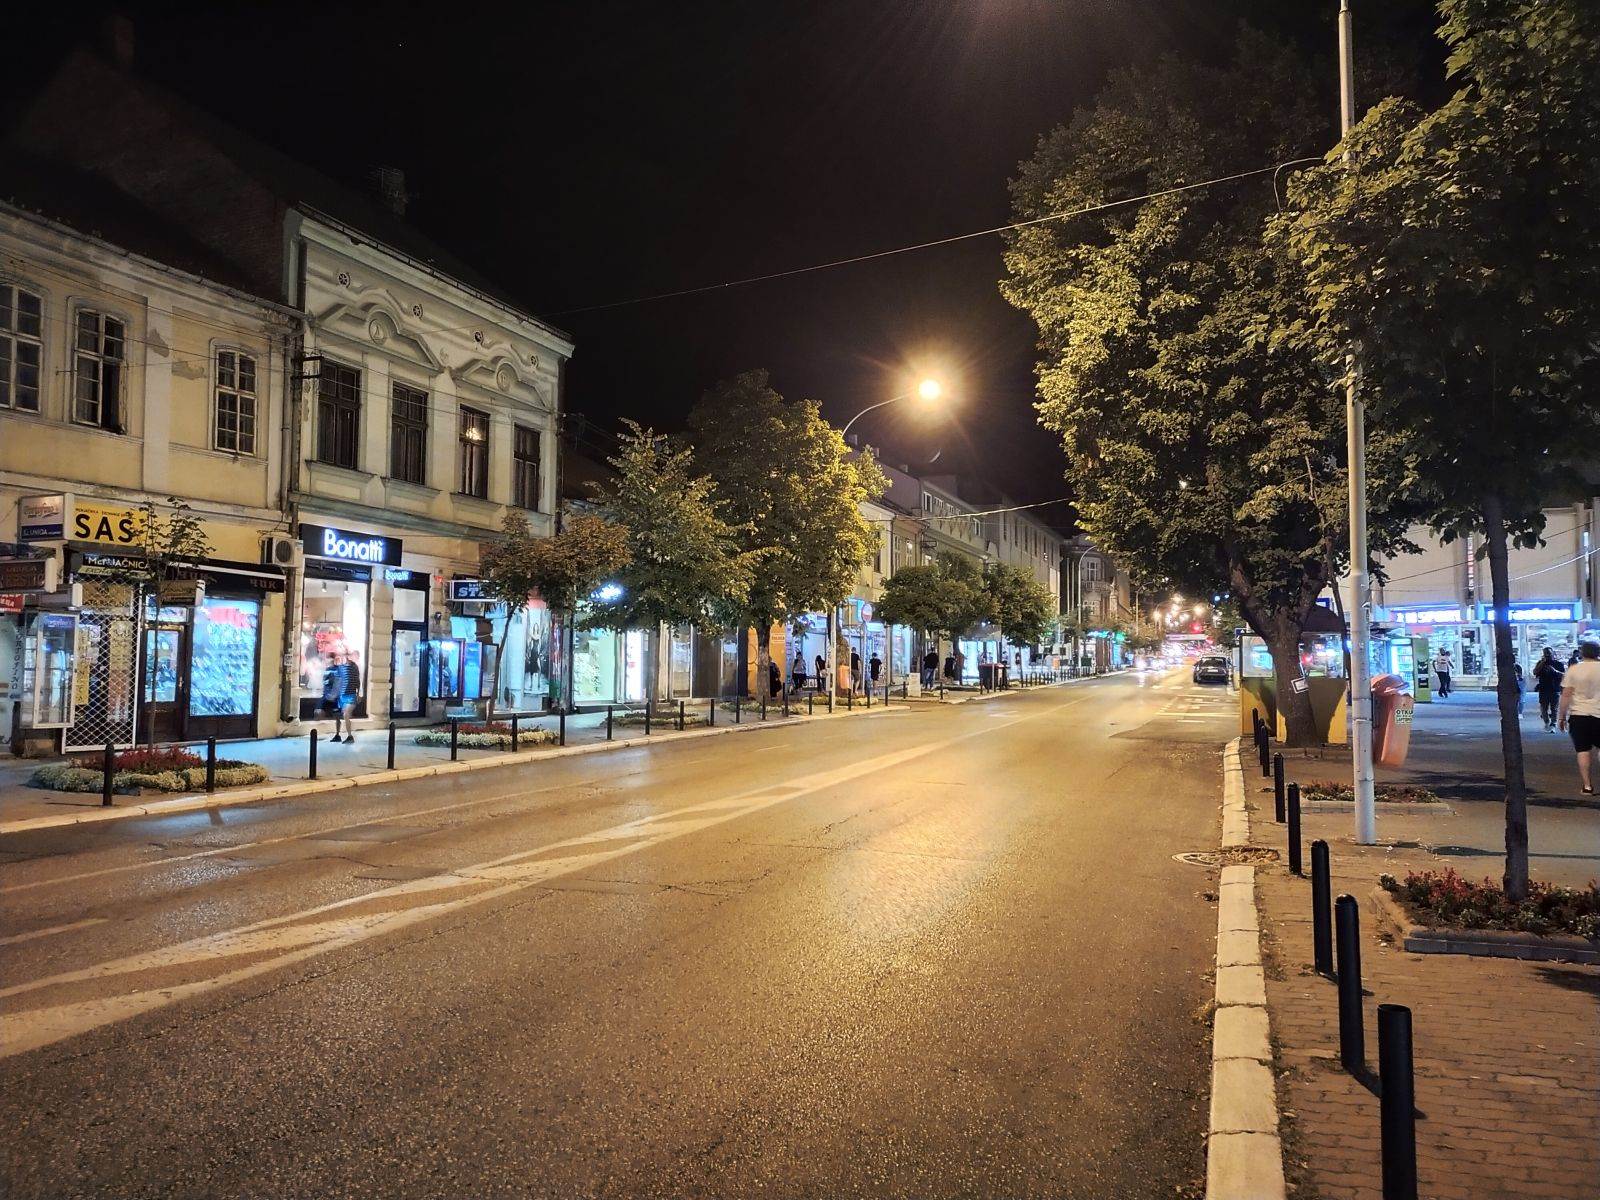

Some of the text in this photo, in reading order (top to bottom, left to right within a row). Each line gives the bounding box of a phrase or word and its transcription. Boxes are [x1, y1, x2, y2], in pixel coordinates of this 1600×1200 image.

[75, 513, 133, 543] SAS
[324, 528, 383, 562] Bonatti
[384, 568, 409, 581] Bonatti
